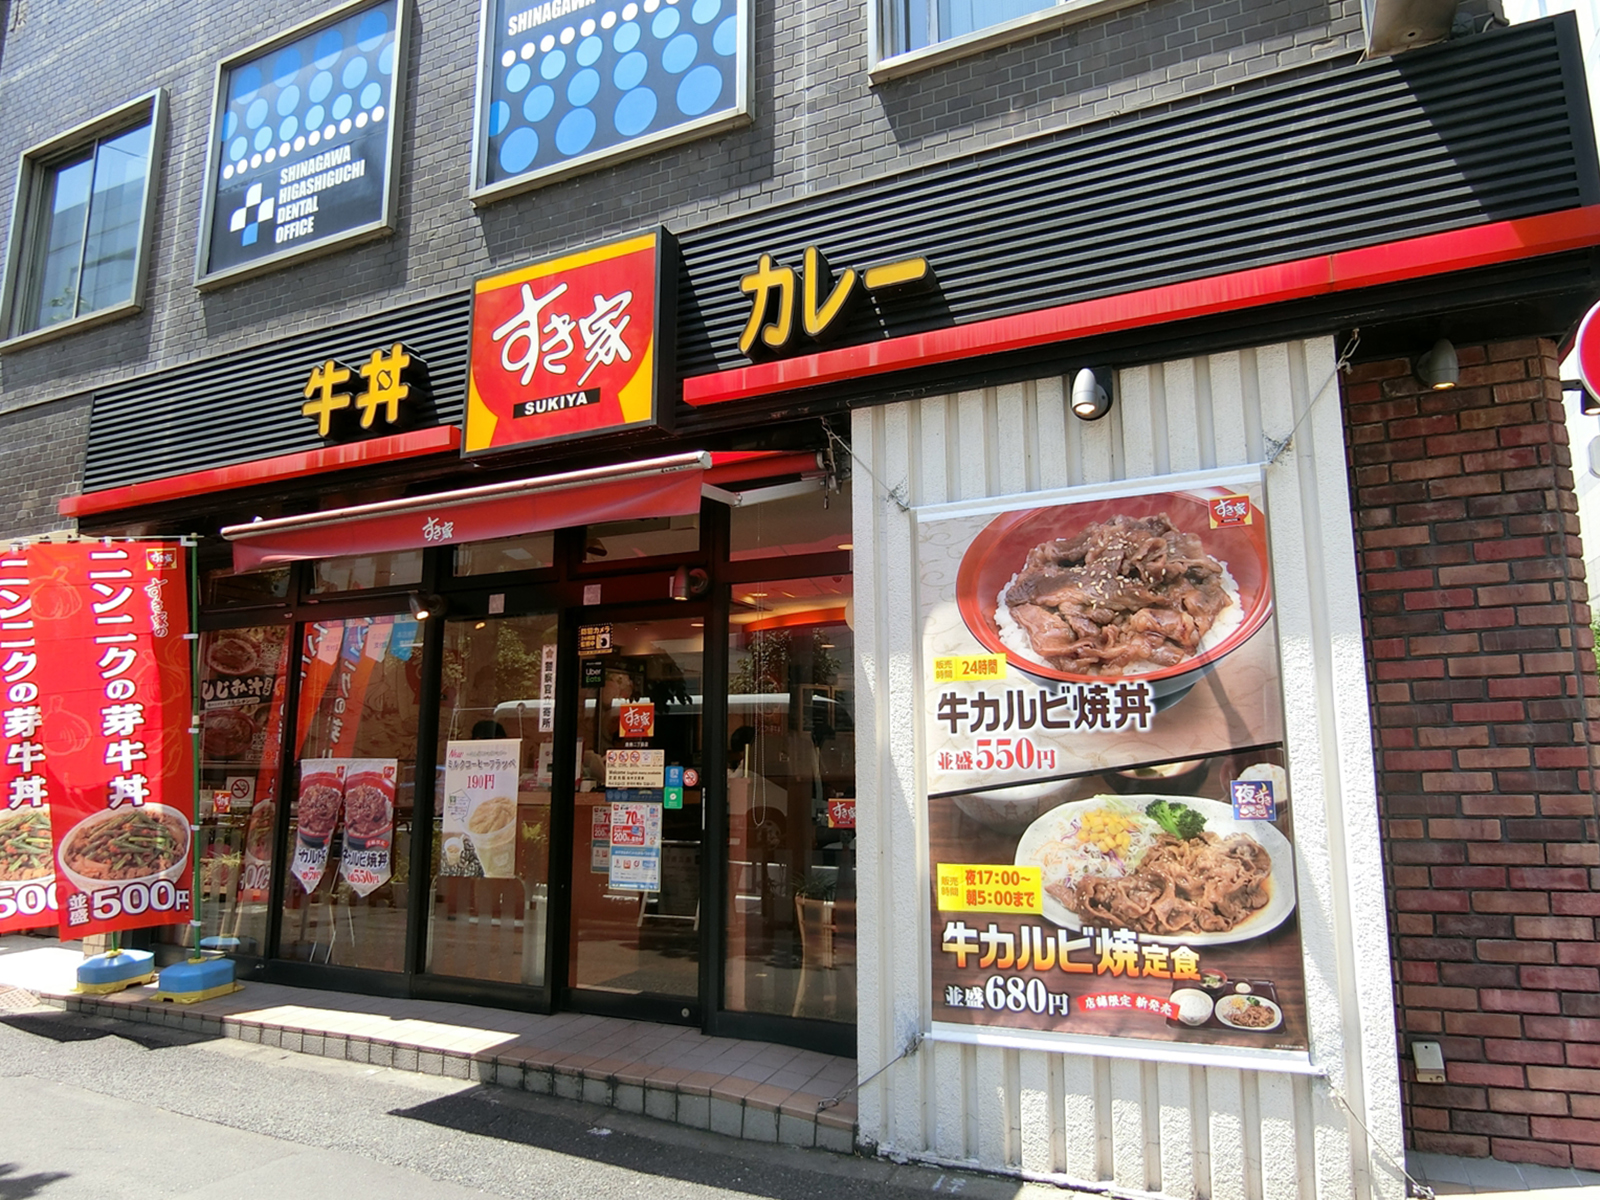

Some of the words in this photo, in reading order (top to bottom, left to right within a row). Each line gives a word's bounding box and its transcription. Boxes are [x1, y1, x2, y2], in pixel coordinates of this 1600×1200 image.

[280, 144, 351, 185] SHINAGAWA
[279, 159, 365, 204] HIGASHIGUCHI
[277, 195, 319, 224] DENTAL
[275, 216, 315, 244] OFFICE
[738, 245, 927, 353] カレー
[492, 282, 634, 387] すき家
[301, 342, 411, 438] 牛丼
[524, 391, 588, 416] SUKIYA
[1214, 499, 1247, 518] すき家
[422, 516, 455, 542] すき家
[585, 668, 602, 676] Uber
[935, 659, 954, 670] 販売
[935, 670, 954, 680] 時間
[961, 660, 998, 676] 24時間
[90, 549, 151, 809] ニンニクの芽牛丼
[202, 676, 264, 700] しじみ汁
[541, 661, 553, 729] 警察官立寄所
[936, 682, 1152, 734] 牛カルビ焼丼
[624, 706, 651, 729] すき家
[447, 758, 517, 771] ミルクコーヒーフラッペ
[936, 737, 1056, 771] 並盛550円
[466, 774, 495, 790] 190円
[625, 810, 638, 825] 70
[91, 880, 190, 920] 500円
[965, 889, 1036, 907] 朝5:00まで
[941, 921, 1202, 981] 牛カルビ焼定食
[943, 975, 1070, 1017] 並盛680円
[1084, 995, 1132, 1010] 店舗限定
[1135, 995, 1174, 1016] 新発売
